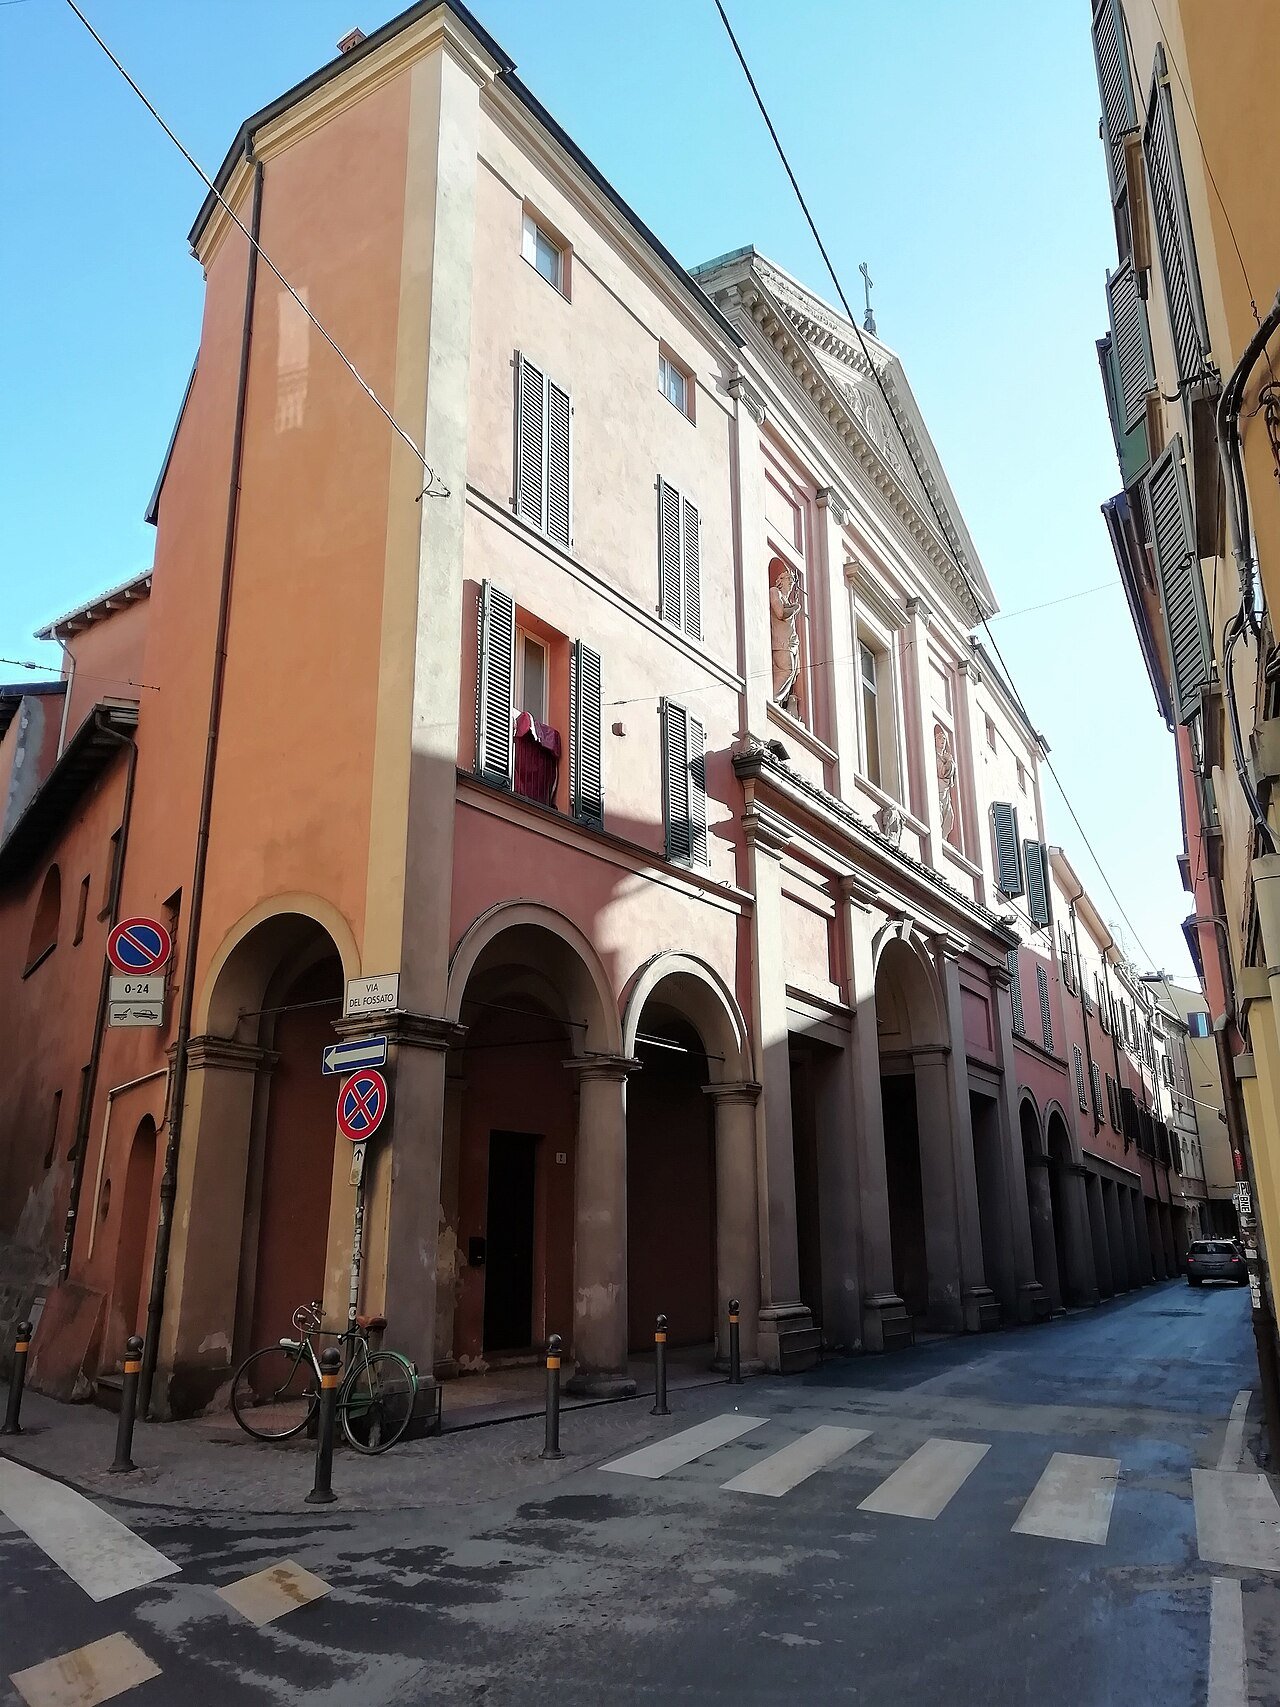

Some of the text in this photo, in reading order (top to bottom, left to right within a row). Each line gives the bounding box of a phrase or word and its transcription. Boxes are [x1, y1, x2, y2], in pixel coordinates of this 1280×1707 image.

[124, 983, 149, 993] 0-24
[366, 983, 379, 992] VIA
[350, 993, 394, 1007] DEL FOSSATO
